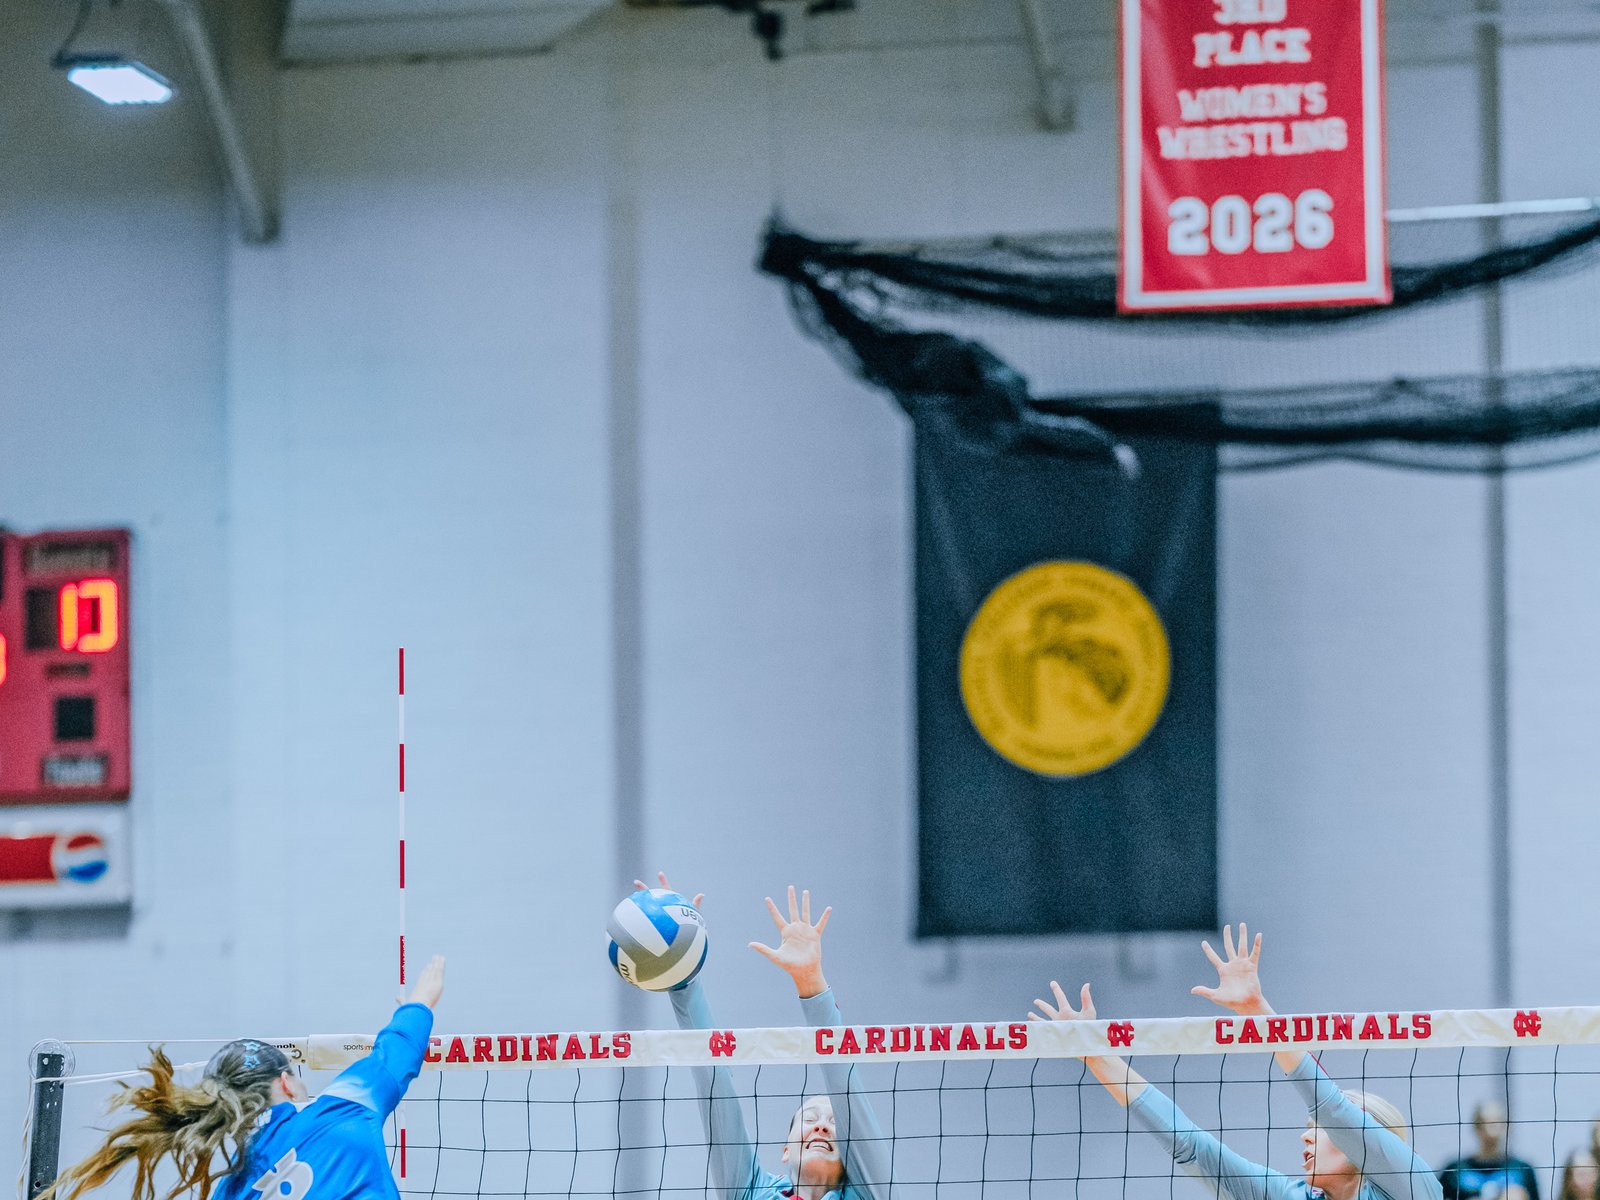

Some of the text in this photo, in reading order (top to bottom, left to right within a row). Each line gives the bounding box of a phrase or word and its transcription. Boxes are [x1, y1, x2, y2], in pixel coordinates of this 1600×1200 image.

[1193, 28, 1311, 67] PLACE
[1178, 81, 1327, 121] WOMEN'S
[1157, 117, 1347, 159] WRESTLING
[1167, 189, 1334, 255] 2026
[425, 1033, 631, 1064] CARDINALS
[815, 1023, 1027, 1055] CARDINALS
[1215, 1013, 1432, 1045] CARDINALS
